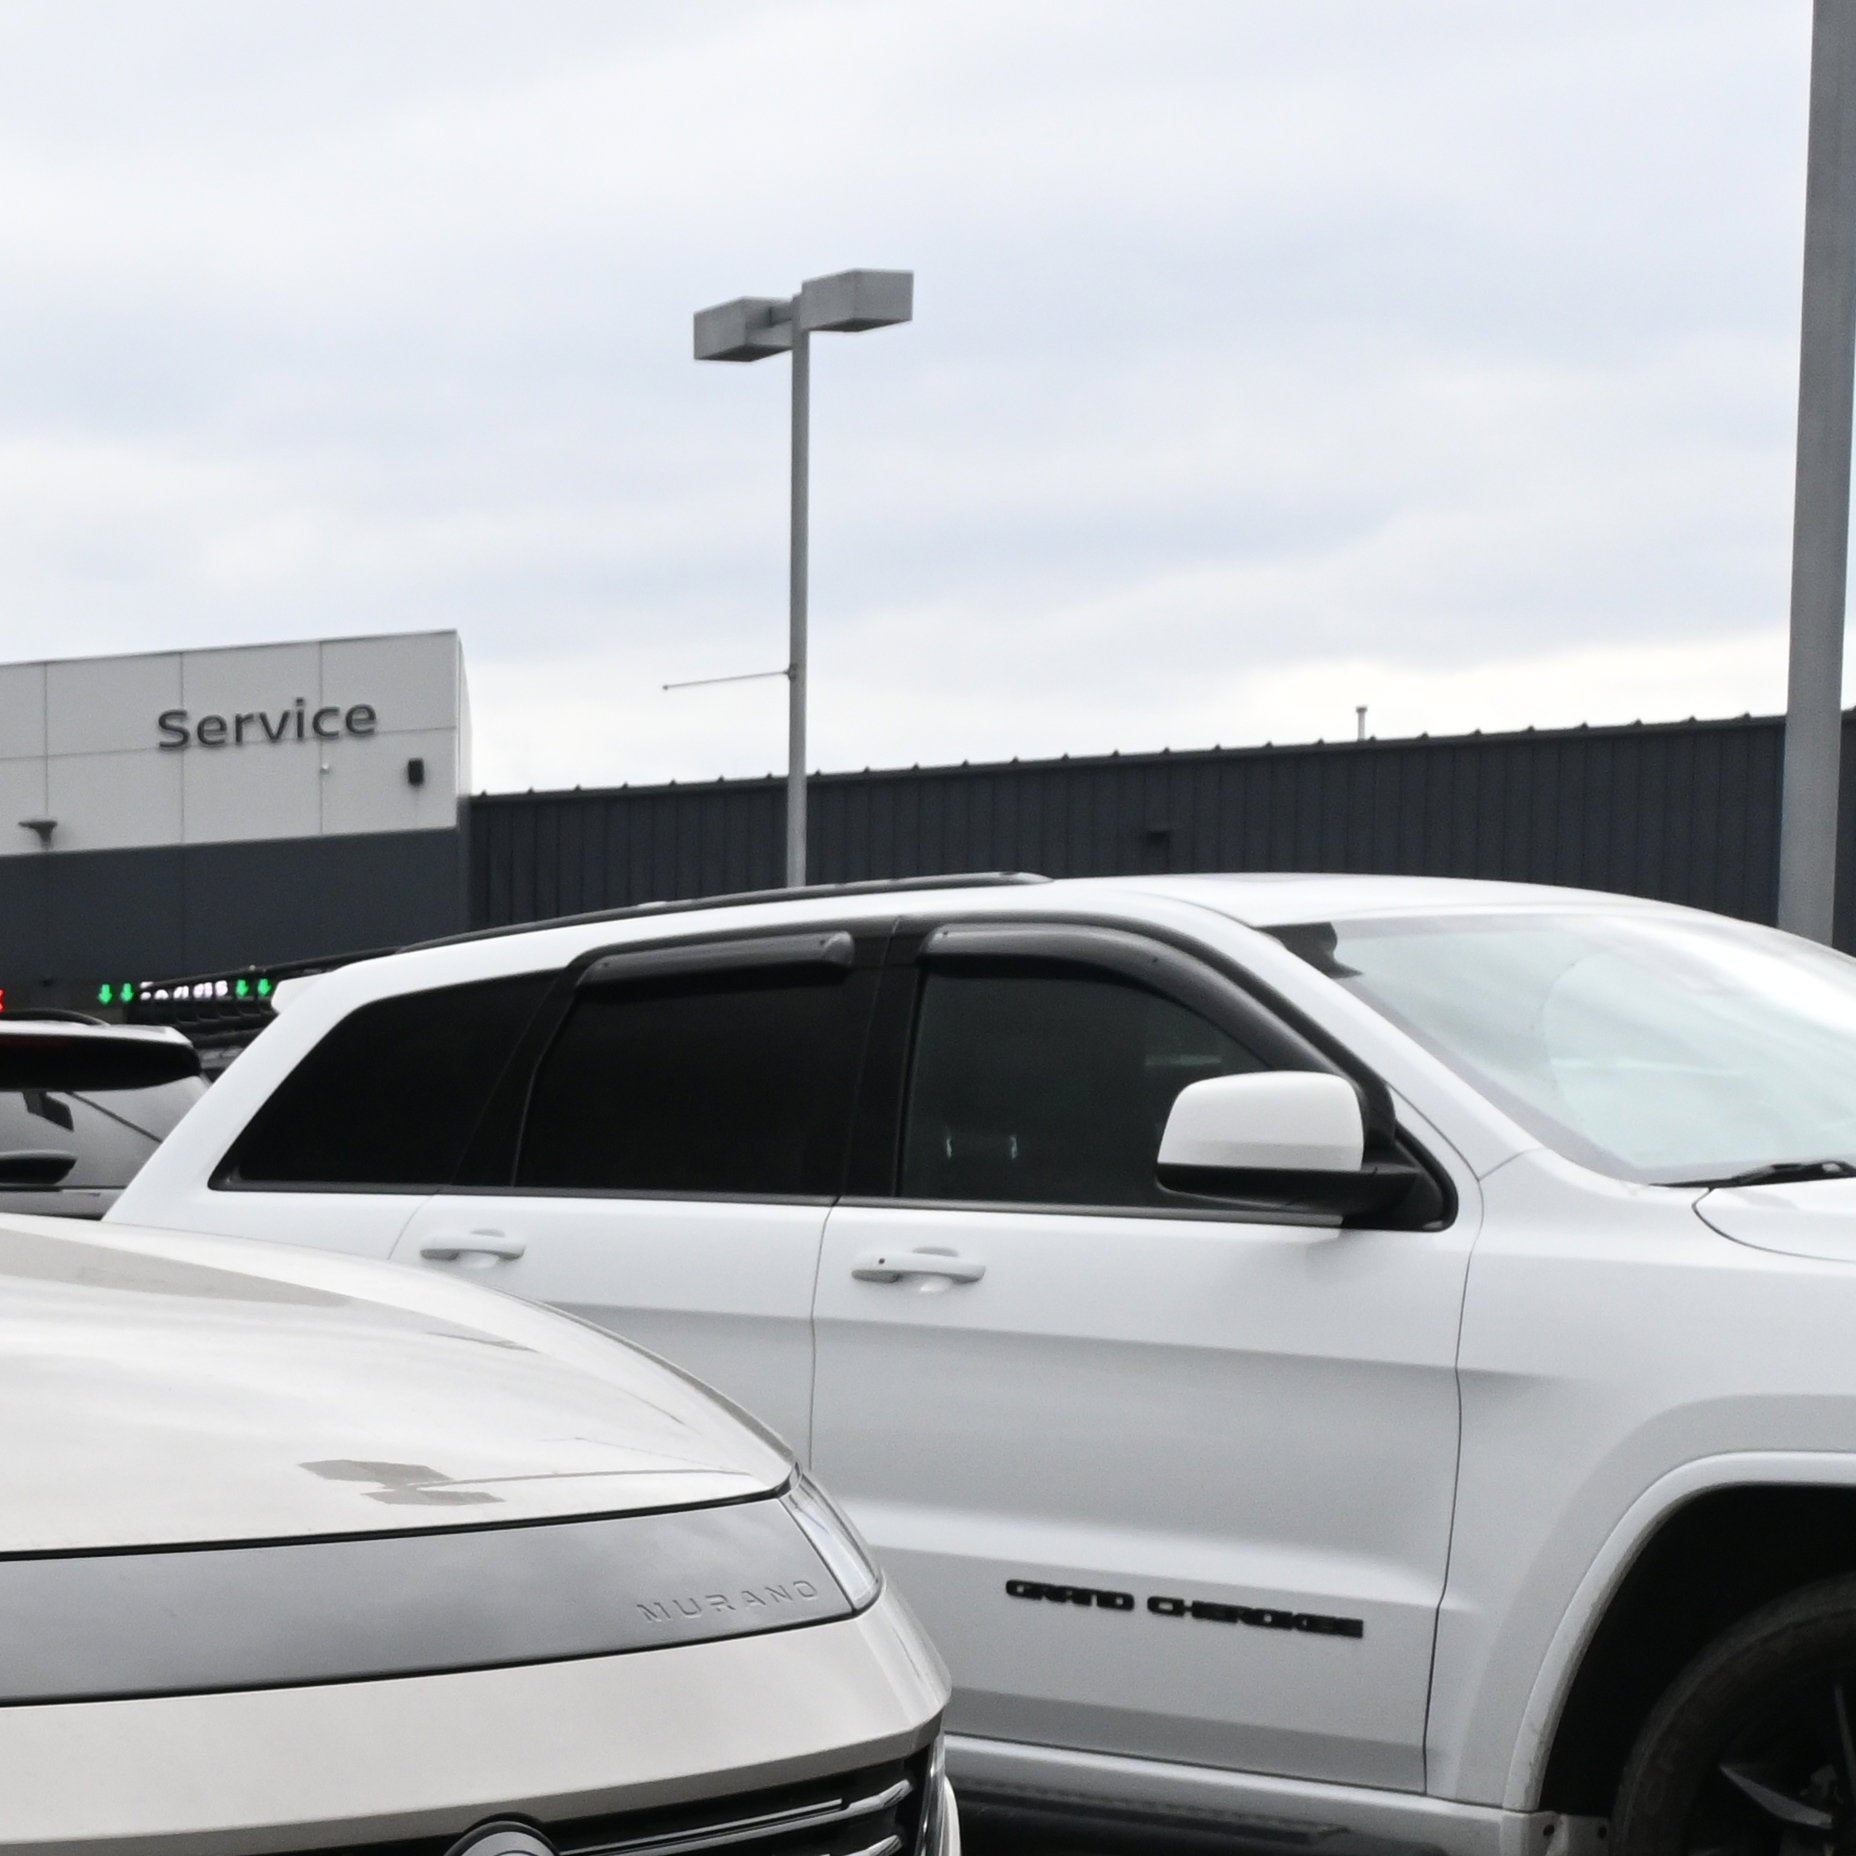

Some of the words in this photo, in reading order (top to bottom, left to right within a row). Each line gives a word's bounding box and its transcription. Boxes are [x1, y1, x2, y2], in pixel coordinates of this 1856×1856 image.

[157, 697, 378, 750] Service
[636, 1579, 819, 1623] MURANO
[1005, 1579, 1135, 1611] GRAND
[1146, 1595, 1364, 1639] CHEROKEE
